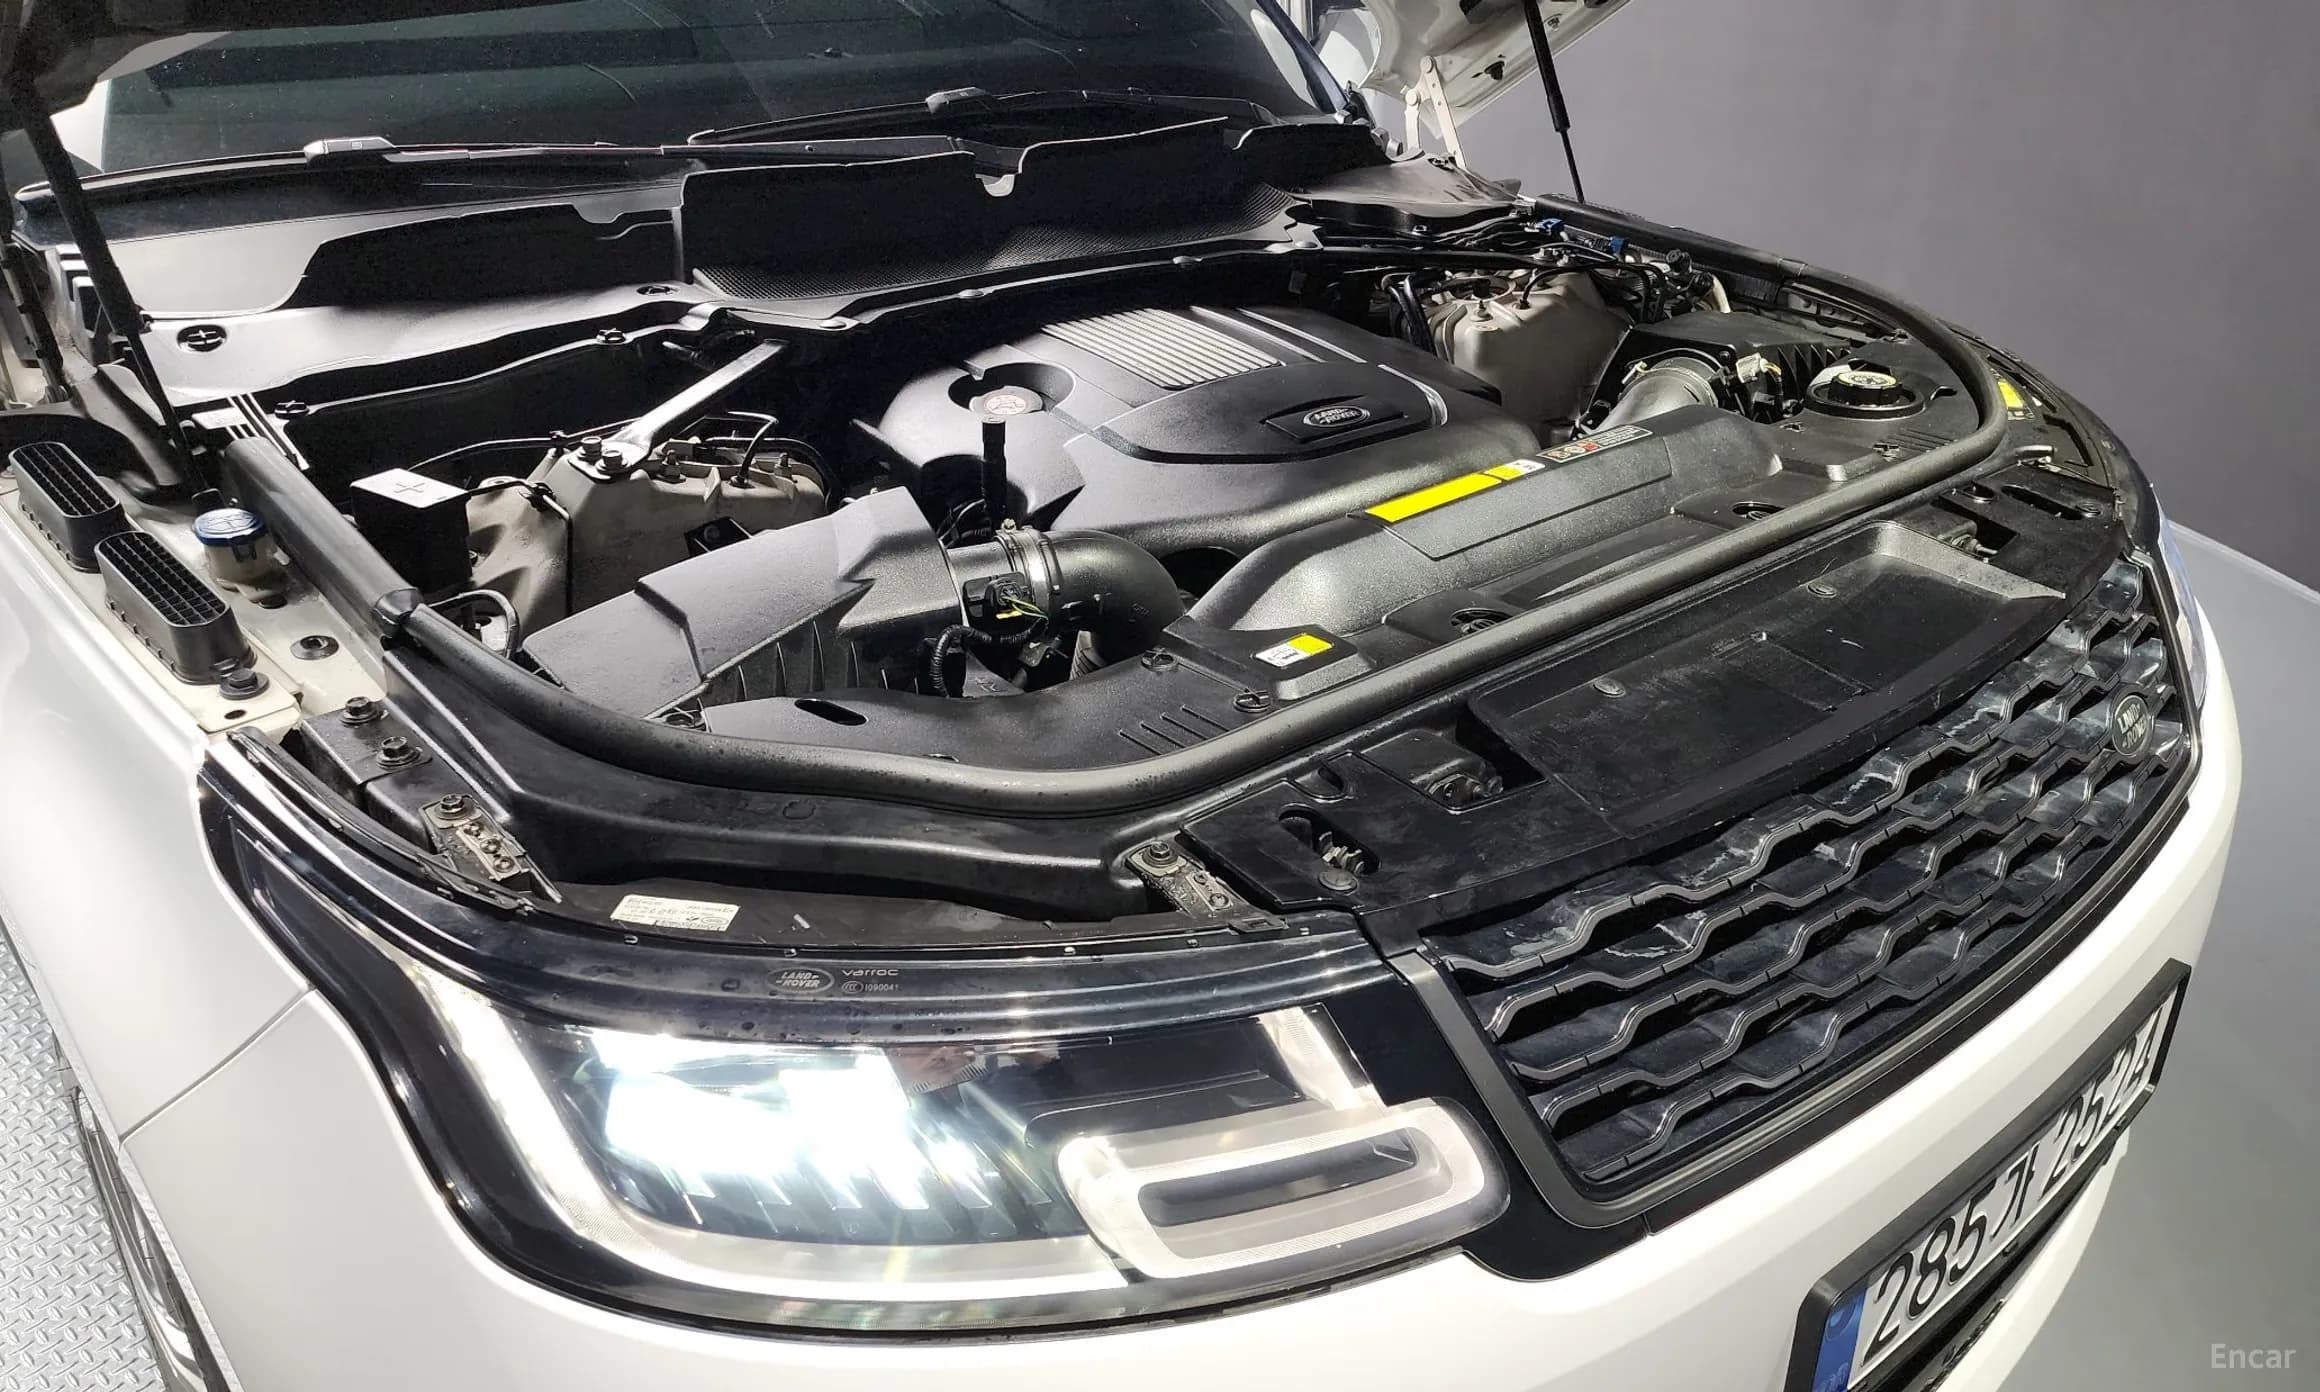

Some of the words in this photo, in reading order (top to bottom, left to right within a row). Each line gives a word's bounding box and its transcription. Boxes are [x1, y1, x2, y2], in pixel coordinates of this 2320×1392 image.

[781, 971, 812, 980] LAND
[841, 969, 900, 977] varroc
[782, 979, 820, 988] ROVER
